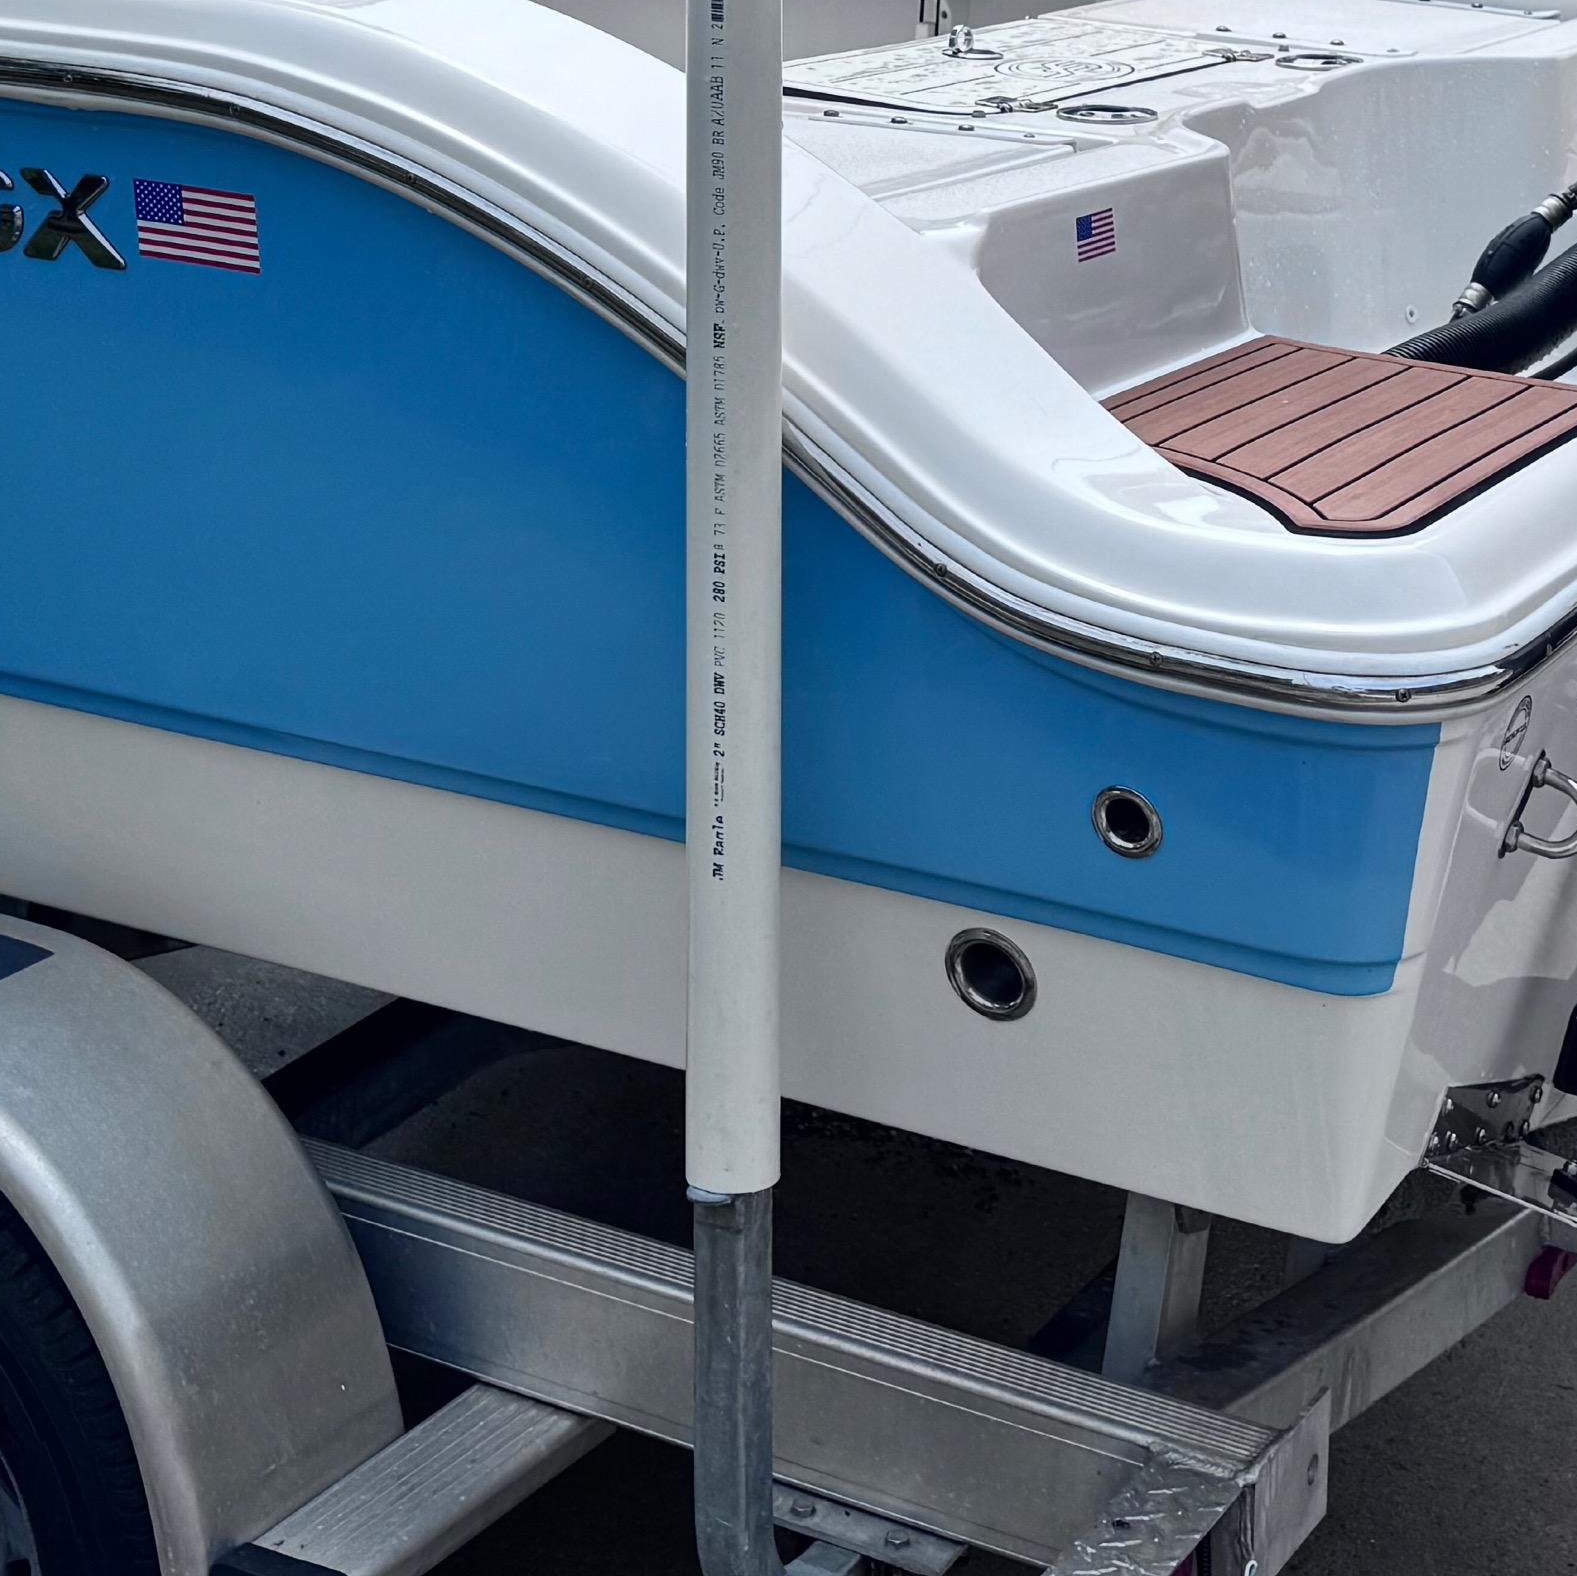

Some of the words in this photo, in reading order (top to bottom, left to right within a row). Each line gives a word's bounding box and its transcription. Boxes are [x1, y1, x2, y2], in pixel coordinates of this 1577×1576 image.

[712, 187, 725, 216] Code
[712, 553, 725, 574] PSI
[712, 581, 725, 603] 280
[712, 701, 725, 736] SCH40
